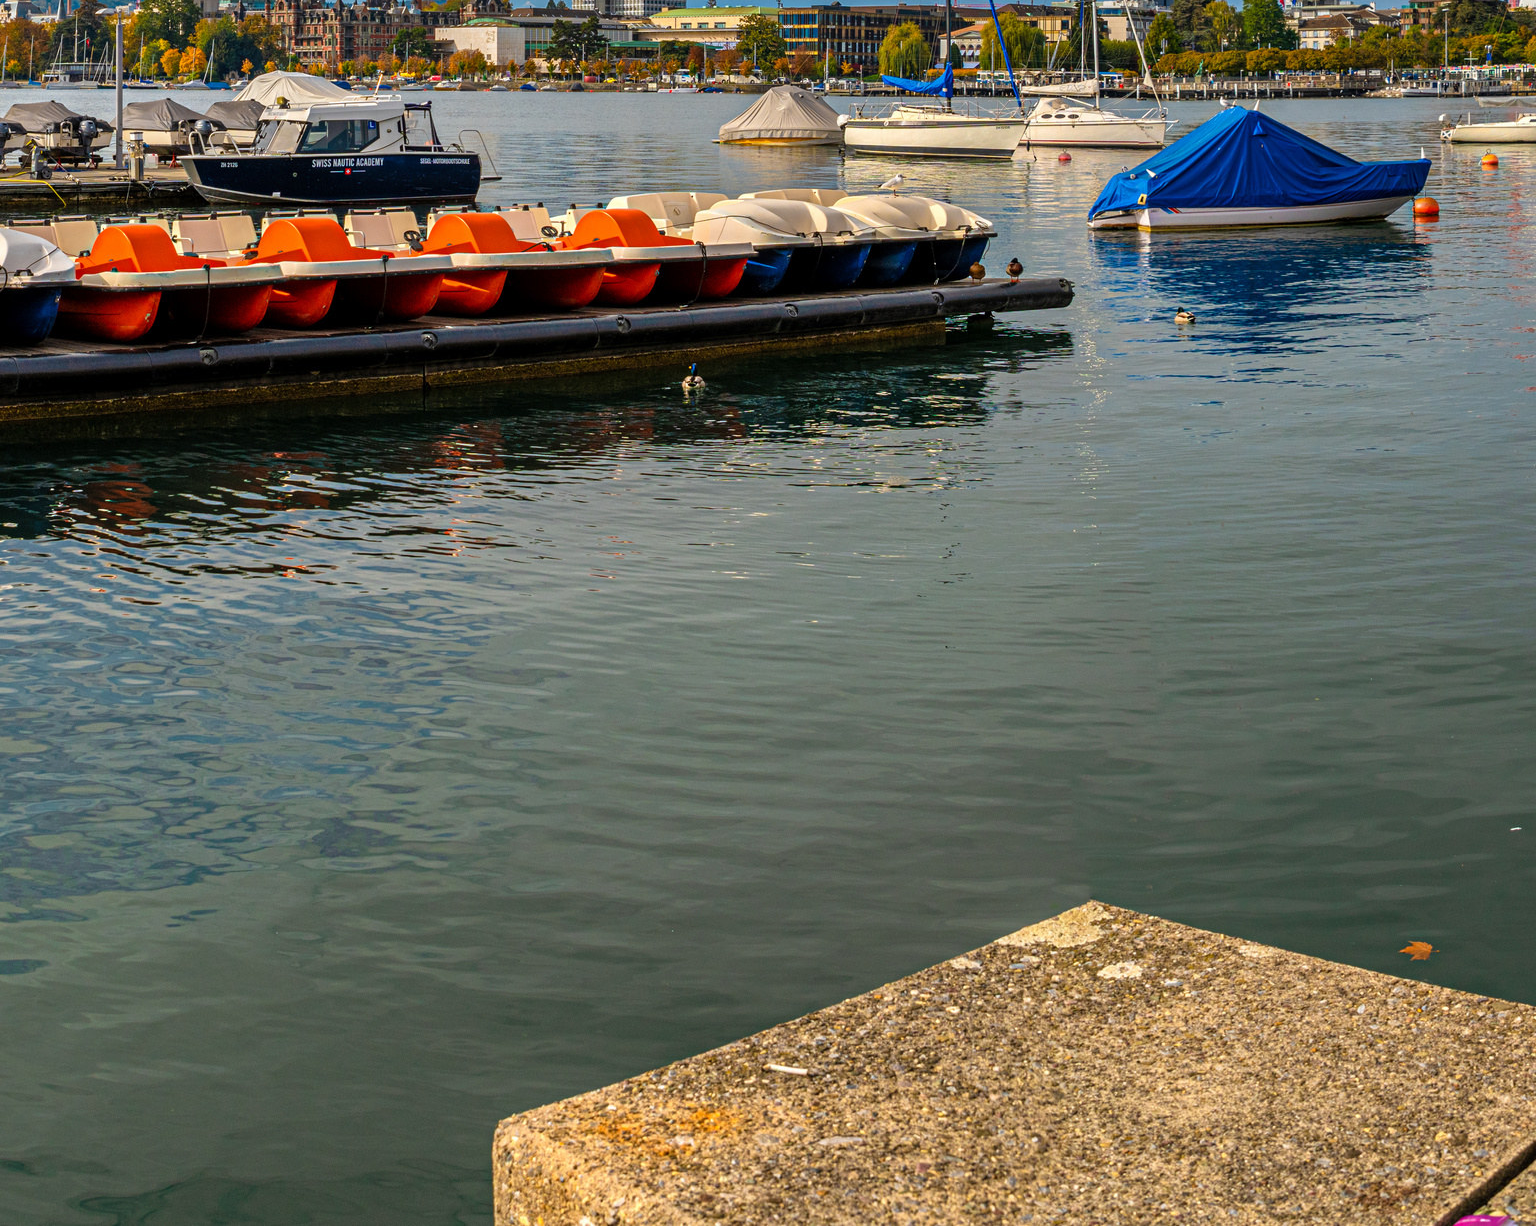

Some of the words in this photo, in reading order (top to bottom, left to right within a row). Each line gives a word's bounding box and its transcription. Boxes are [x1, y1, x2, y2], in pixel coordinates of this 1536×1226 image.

[311, 159, 332, 167] SWISS
[333, 158, 355, 167] NAUTIC
[356, 158, 384, 167] ACADEMY
